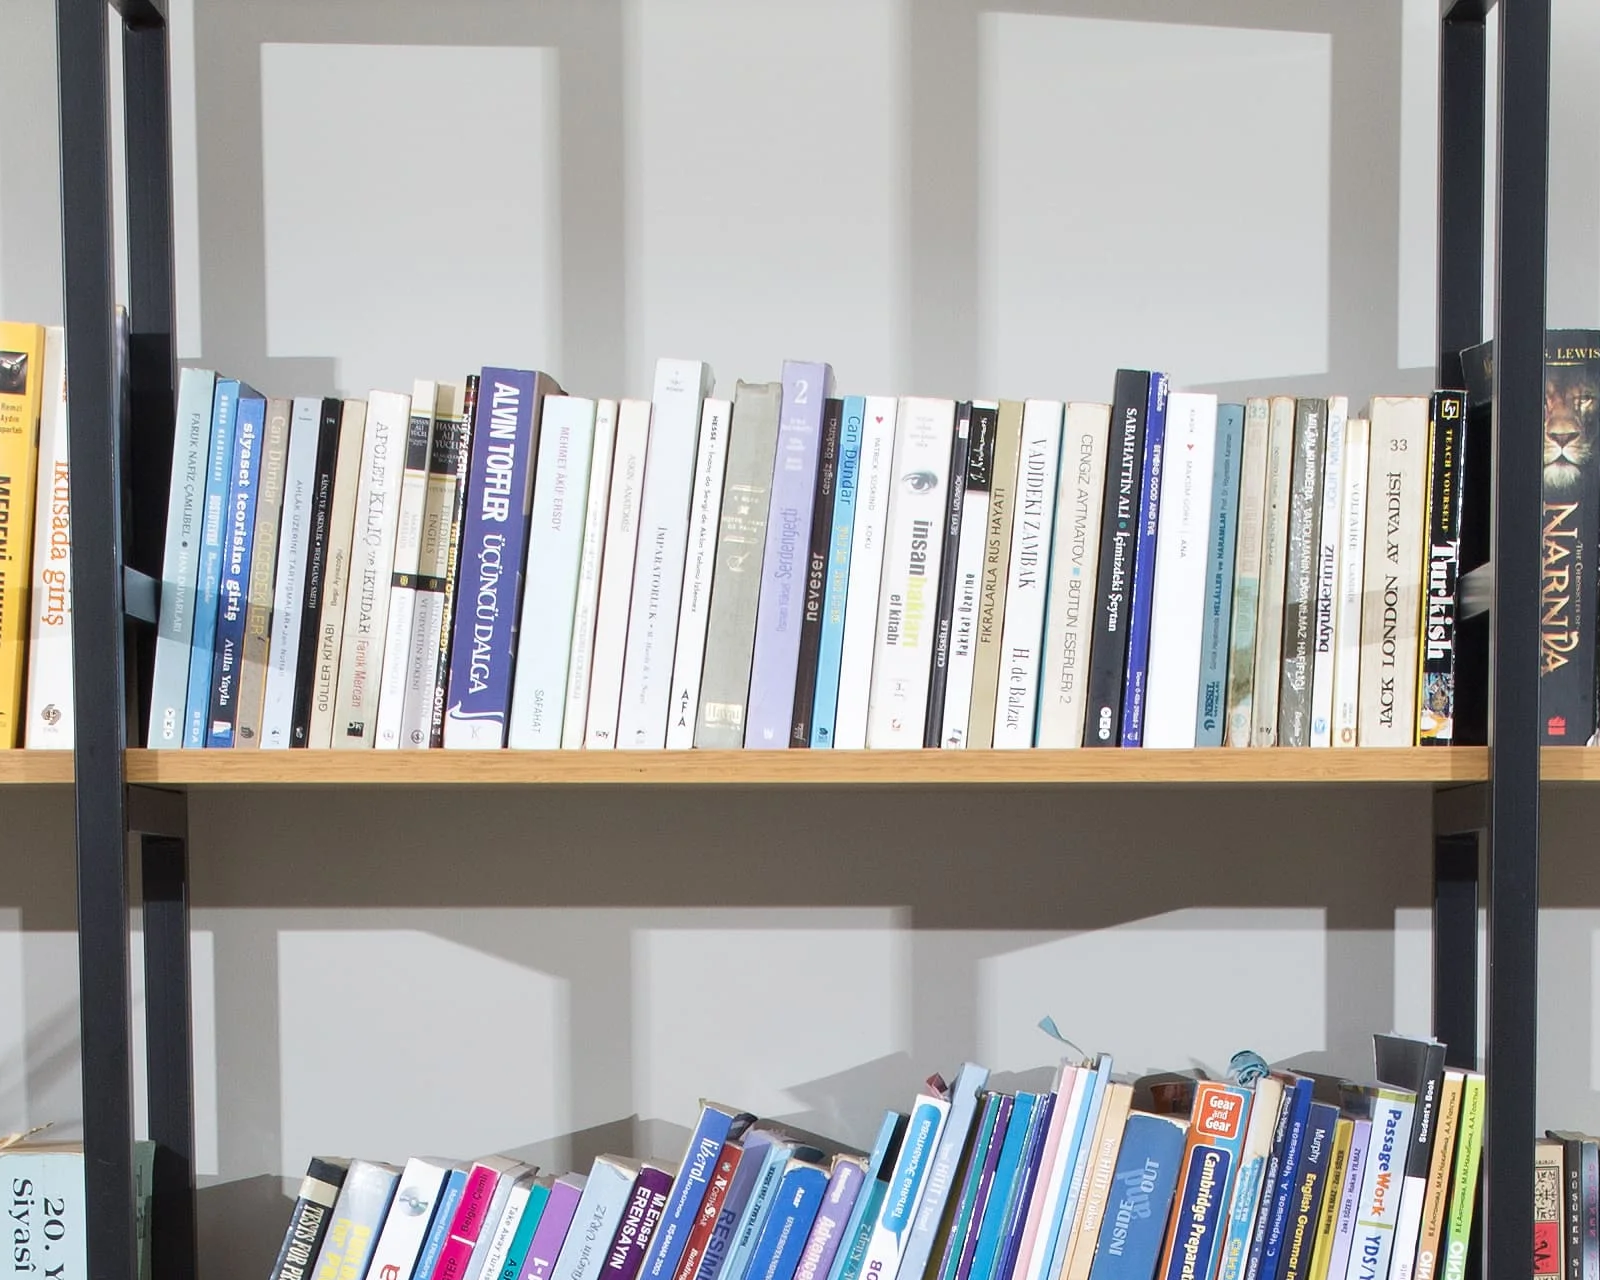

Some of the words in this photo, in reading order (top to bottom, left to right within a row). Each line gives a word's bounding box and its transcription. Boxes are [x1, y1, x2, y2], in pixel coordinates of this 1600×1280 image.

[490, 383, 520, 440] ALVIN
[237, 423, 254, 486] siyaset
[1118, 407, 1139, 494] SABAHATTİN
[1444, 429, 1454, 467] TEACH
[481, 445, 514, 521] TOFFLER
[1118, 496, 1133, 519] ALİ
[1441, 471, 1452, 532] YOURSELF
[231, 494, 248, 574] teorisine
[1018, 520, 1041, 589] ZAMBAK
[1108, 531, 1128, 591] İçimizdeki
[1386, 539, 1399, 564] AY
[224, 580, 243, 621] giriş
[474, 535, 505, 620] ÜÇÜNCÜ
[805, 553, 825, 622] neveser
[1425, 540, 1459, 661] Turkish
[886, 609, 901, 646] kitabı
[1104, 593, 1124, 632] Şeytan
[1381, 574, 1398, 668] LONDON
[468, 625, 493, 694] DALGA
[1010, 667, 1026, 684] de
[1012, 648, 1030, 664] H.
[218, 673, 233, 706] Yayla
[1005, 687, 1025, 729] Balzac
[1380, 678, 1394, 728] JACK
[1308, 1128, 1326, 1163] Murphy
[1190, 1152, 1221, 1224] Cambridge
[1298, 1173, 1317, 1212] English
[43, 1198, 65, 1251] 20.
[610, 1186, 650, 1270] ERENSAYIN
